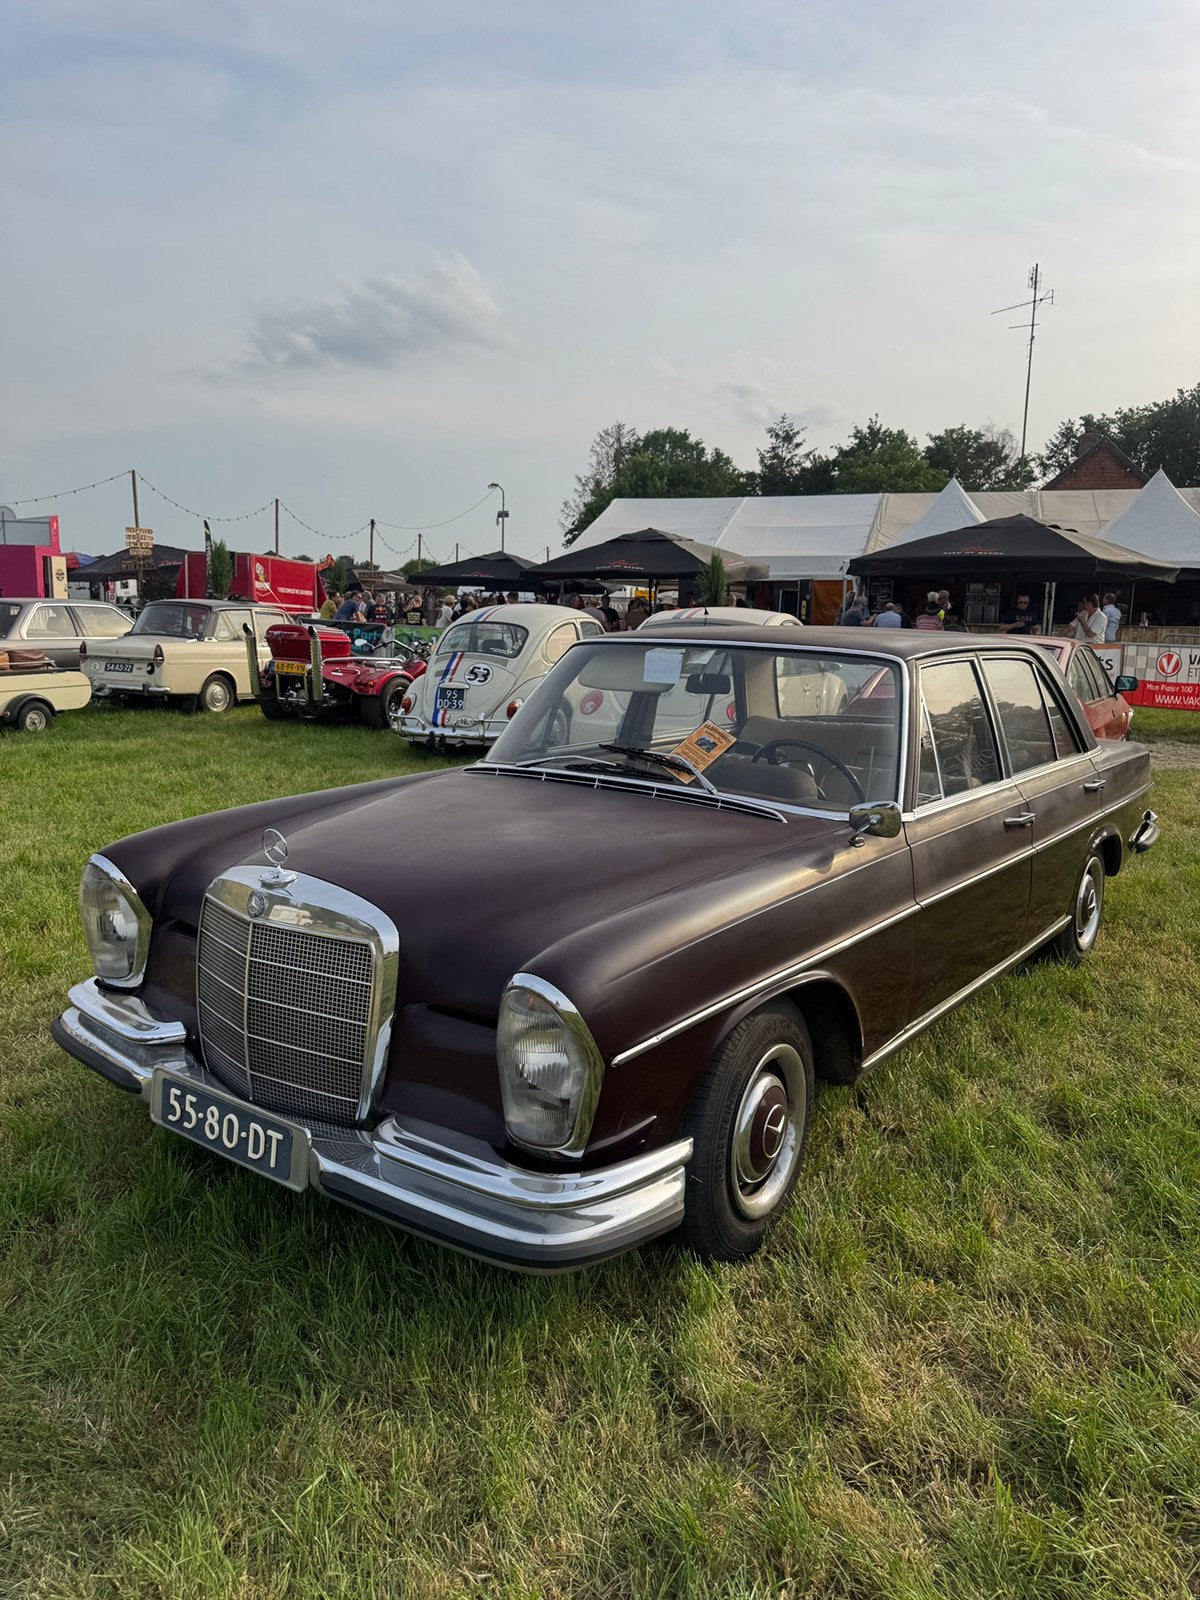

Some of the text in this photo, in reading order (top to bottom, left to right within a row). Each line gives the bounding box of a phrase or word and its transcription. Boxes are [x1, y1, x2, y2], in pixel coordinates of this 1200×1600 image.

[275, 662, 306, 672] 68-PF-VN
[467, 666, 491, 683] 53
[1146, 683, 1160, 691] Mon
[1181, 685, 1194, 693] 100
[446, 689, 458, 699] 95
[437, 699, 465, 710] DD-39
[167, 1087, 284, 1169] 55-80-DT
